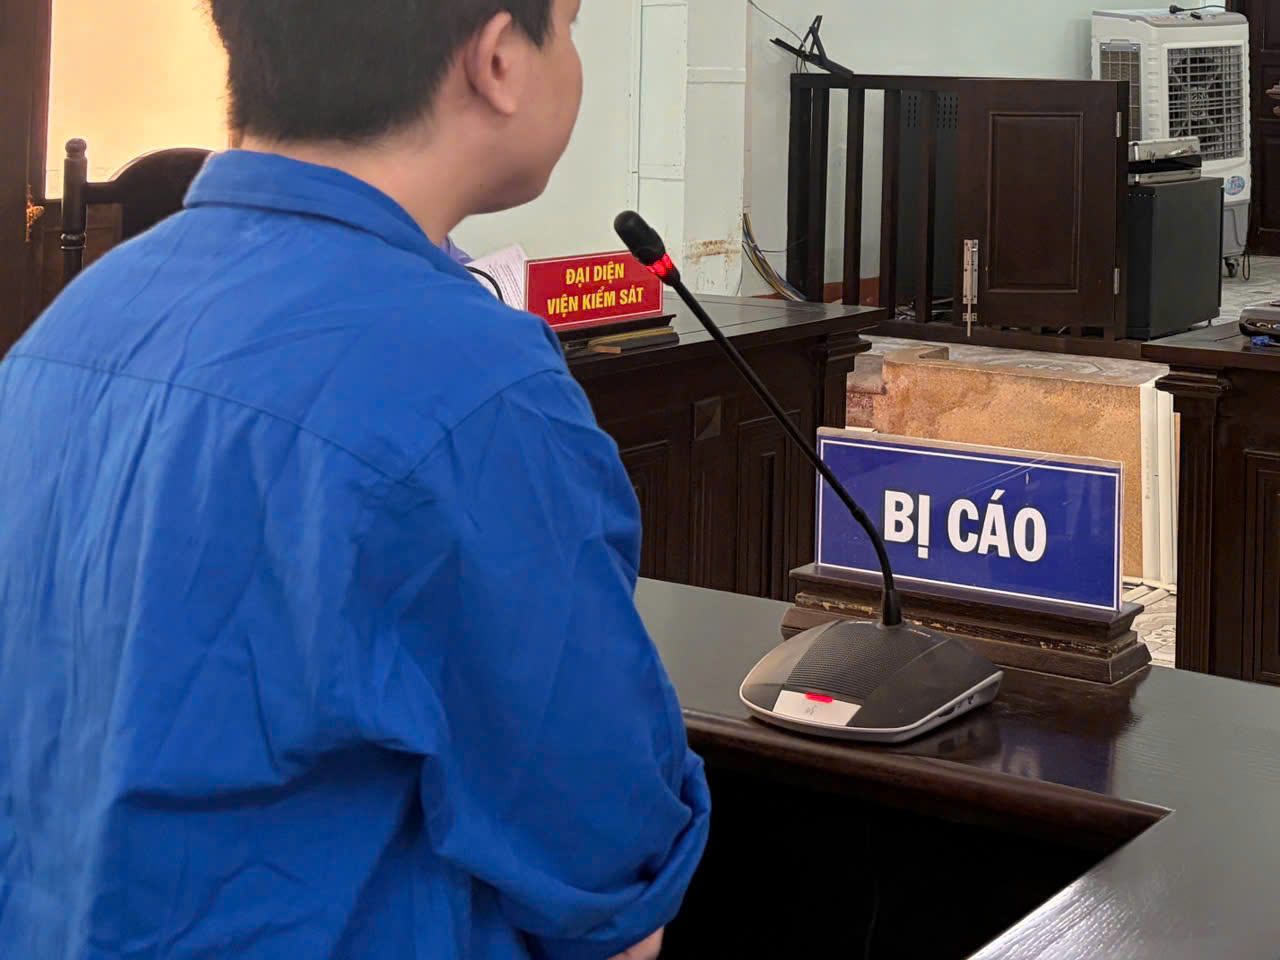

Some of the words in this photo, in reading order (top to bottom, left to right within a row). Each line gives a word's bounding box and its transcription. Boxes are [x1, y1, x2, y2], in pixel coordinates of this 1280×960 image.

[566, 267, 590, 288] ĐẠI
[594, 261, 625, 284] DIỆN
[547, 294, 578, 318] VIỆN
[582, 286, 616, 310] KIỂM
[619, 285, 644, 305] SÁT
[884, 489, 931, 559] BỊ
[947, 489, 1047, 562] CÁO
